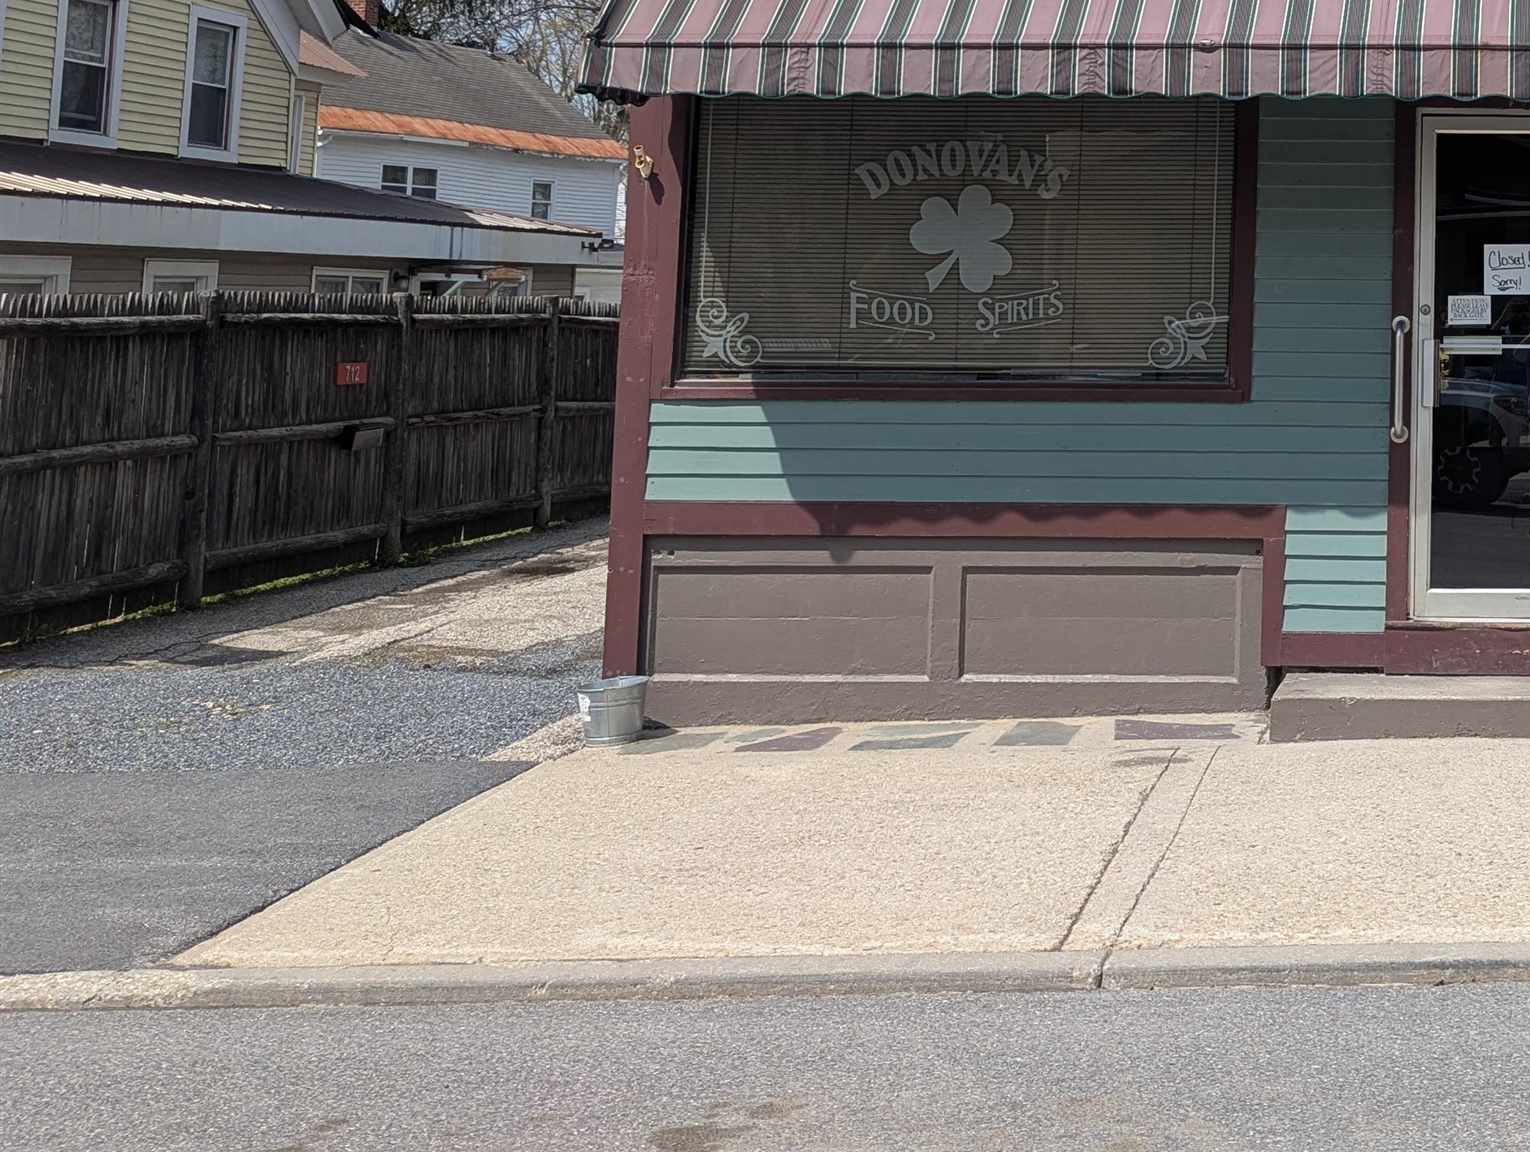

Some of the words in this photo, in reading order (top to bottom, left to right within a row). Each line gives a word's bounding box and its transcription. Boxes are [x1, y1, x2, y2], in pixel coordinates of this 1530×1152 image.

[853, 139, 1070, 199] DONOVAN'S
[849, 291, 933, 329] FOOD
[975, 291, 1064, 331] SPIRITS
